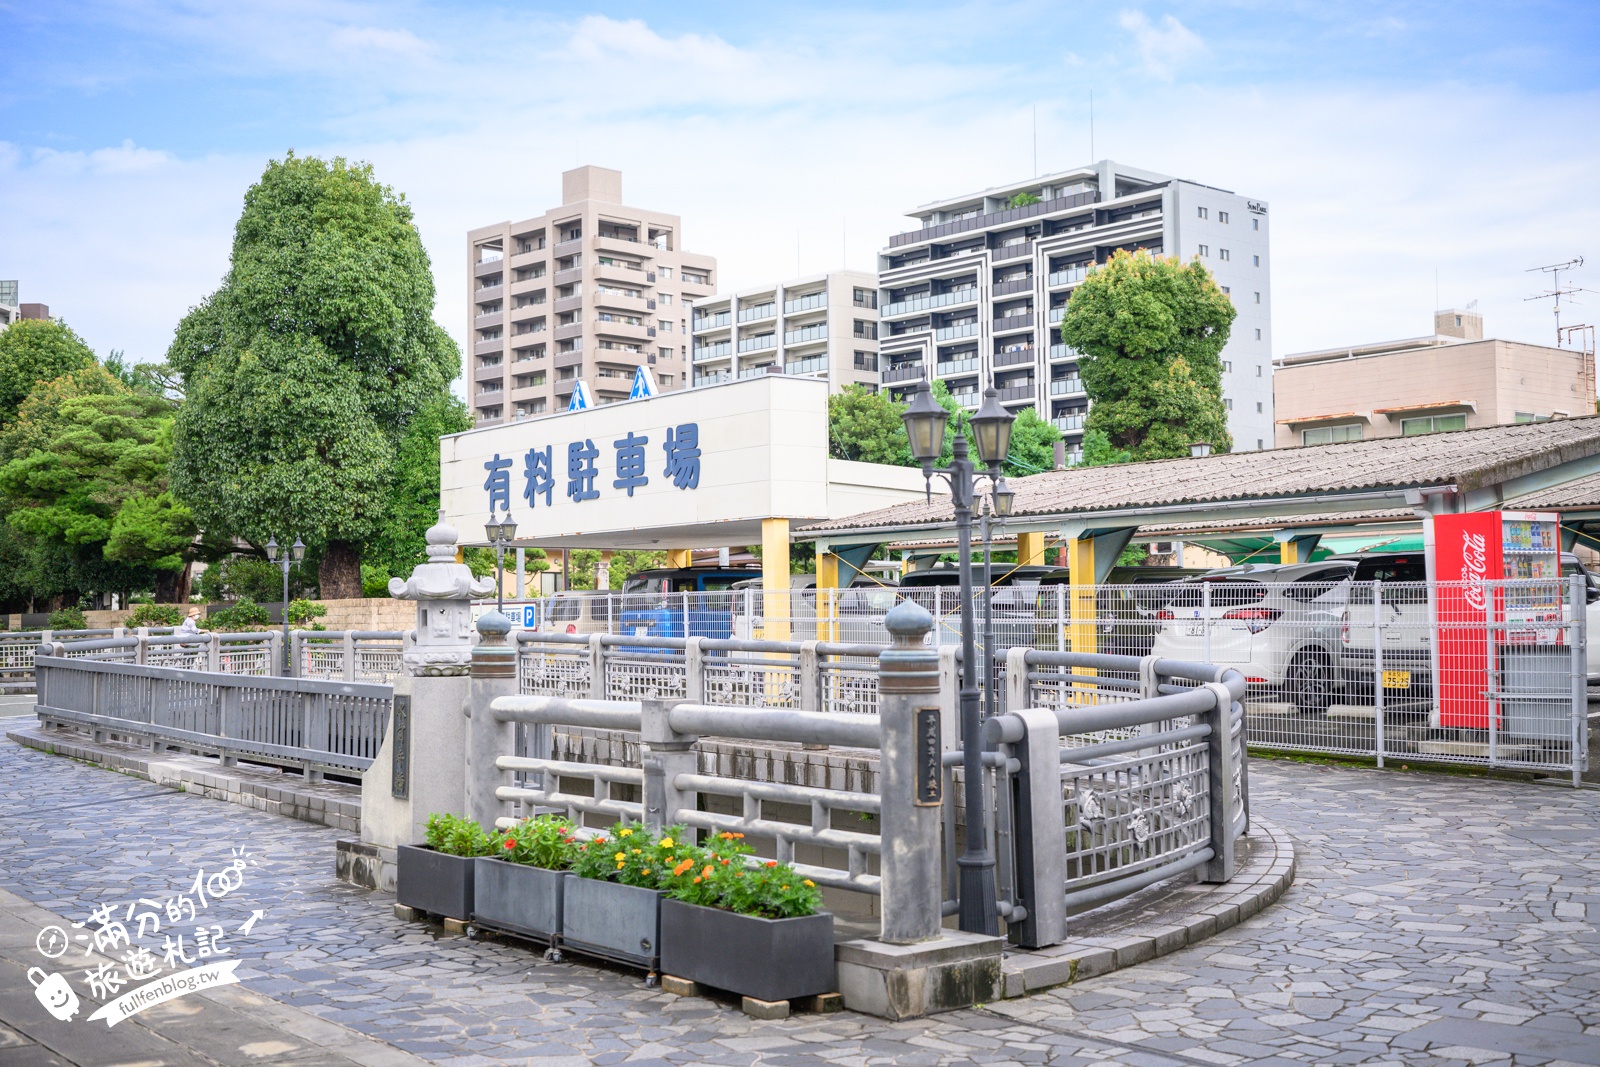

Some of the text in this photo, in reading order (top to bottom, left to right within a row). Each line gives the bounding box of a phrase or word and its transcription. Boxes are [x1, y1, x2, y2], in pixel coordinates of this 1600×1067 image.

[484, 423, 701, 513] 有料駐車場
[1463, 529, 1486, 610] Coca-Cola
